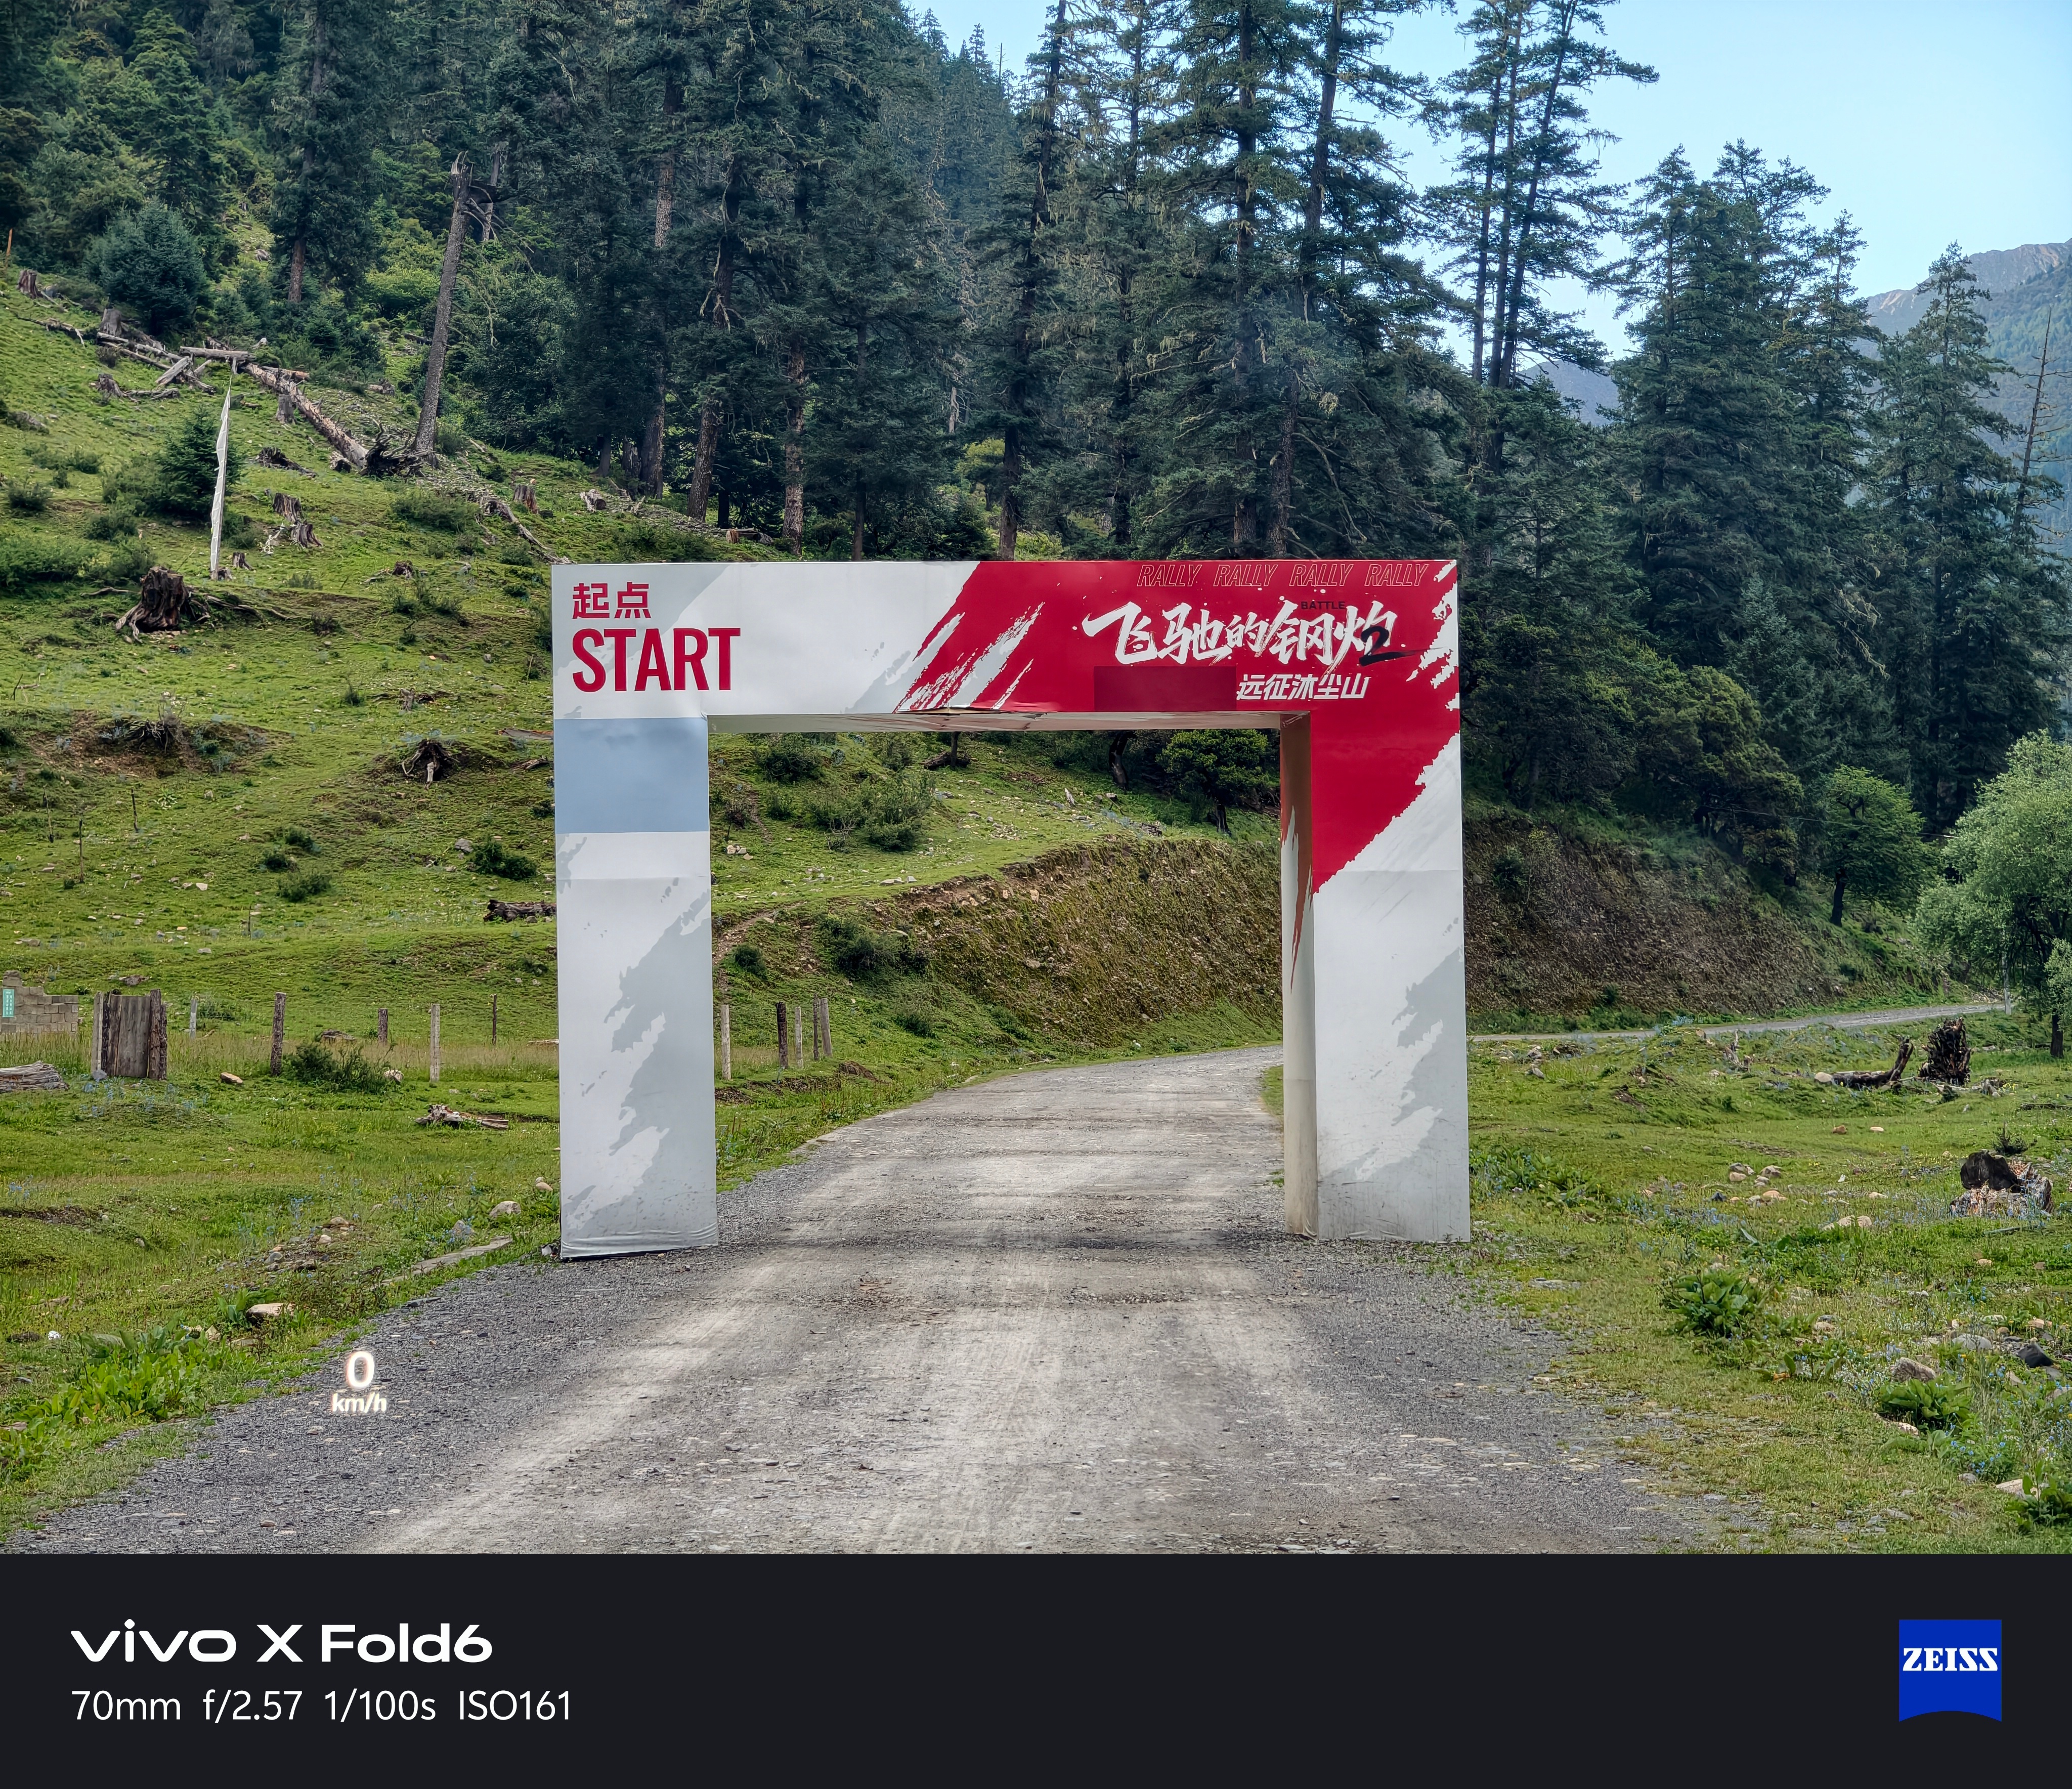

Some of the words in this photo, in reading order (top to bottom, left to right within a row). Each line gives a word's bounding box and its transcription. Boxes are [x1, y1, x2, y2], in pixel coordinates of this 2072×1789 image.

[1137, 564, 1202, 587] RALLY
[1213, 564, 1278, 587] RALLY
[1289, 564, 1354, 587] RALLY
[1364, 564, 1429, 587] RALLY
[572, 582, 651, 619] 起点
[1301, 601, 1346, 610] BATTLE
[572, 627, 741, 693] START
[1236, 673, 1371, 701] 远征沐尘山
[346, 1350, 375, 1388] 0
[331, 1391, 388, 1414] km/h
